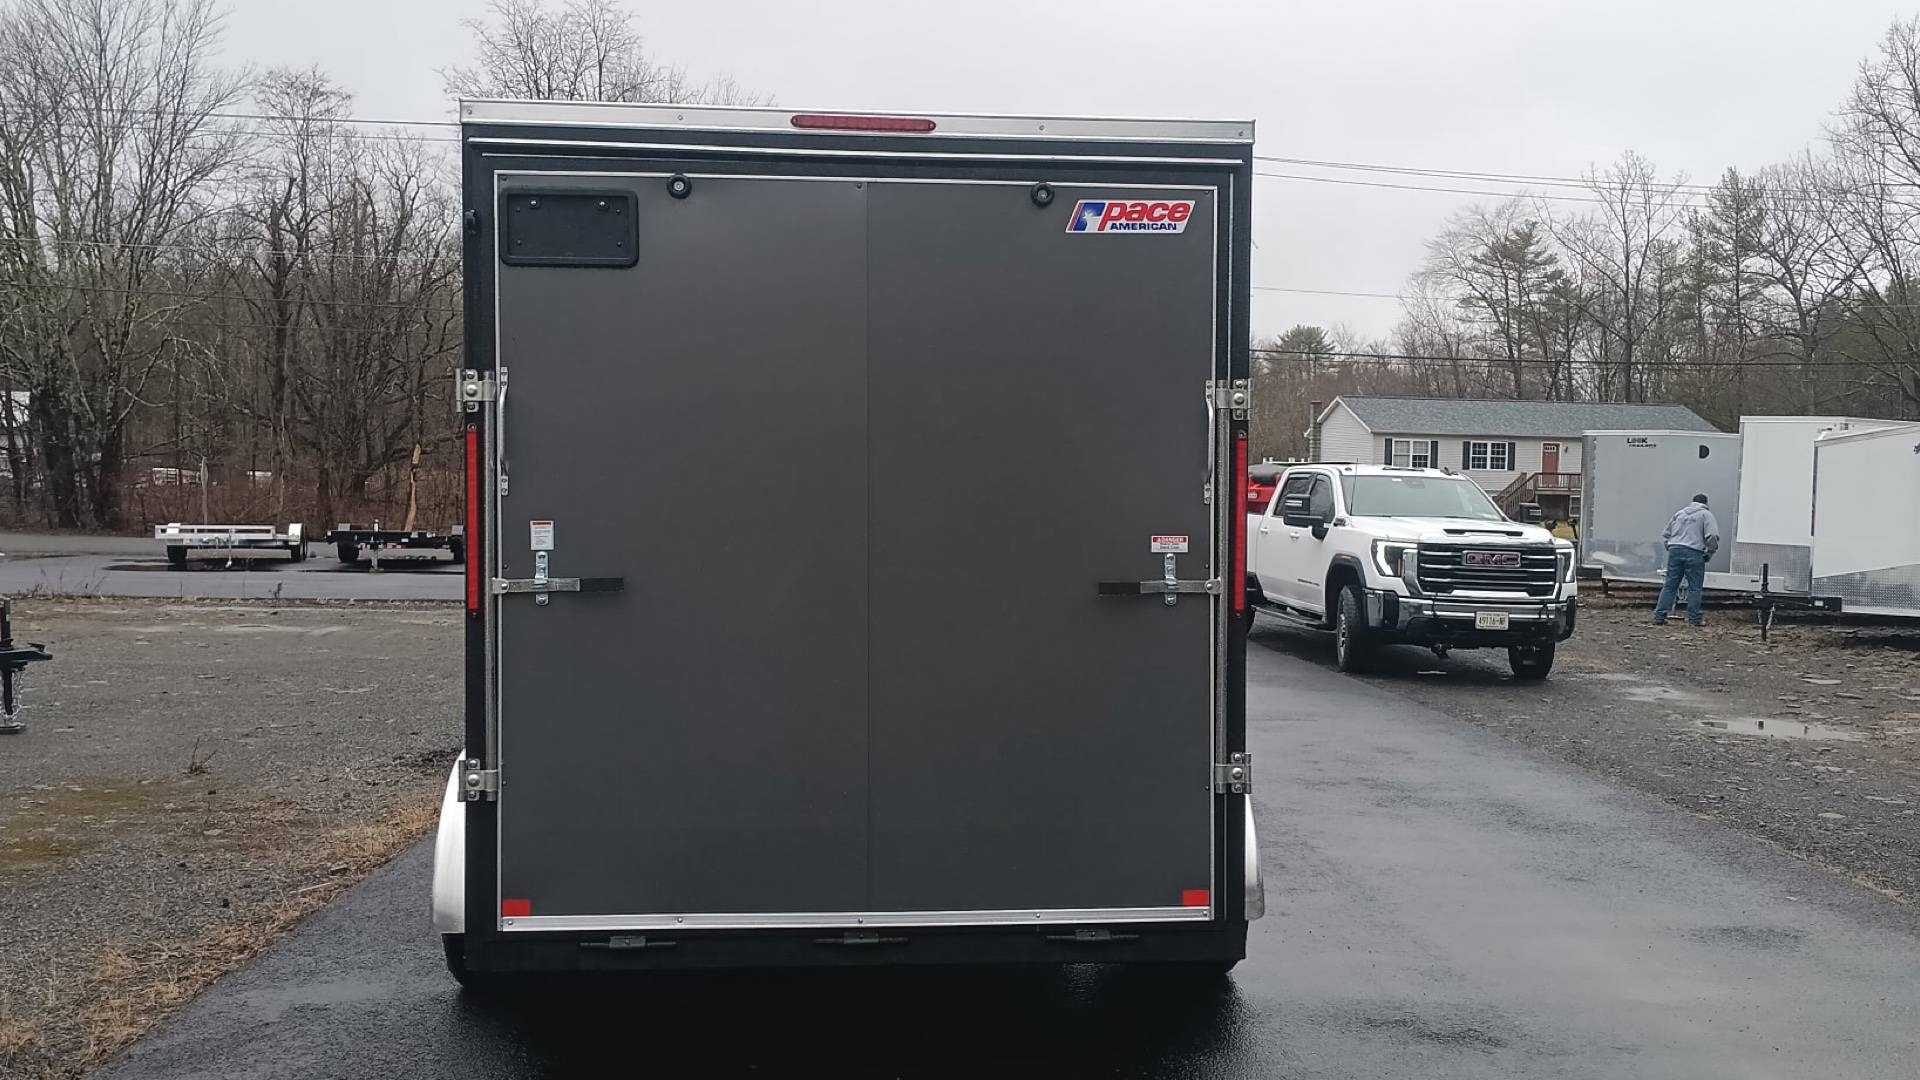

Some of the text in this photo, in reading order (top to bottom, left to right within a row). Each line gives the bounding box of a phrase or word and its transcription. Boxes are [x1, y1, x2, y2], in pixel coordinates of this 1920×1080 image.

[1098, 202, 1191, 231] pace
[1110, 222, 1177, 231] AMERICAN
[1466, 553, 1519, 565] GMC
